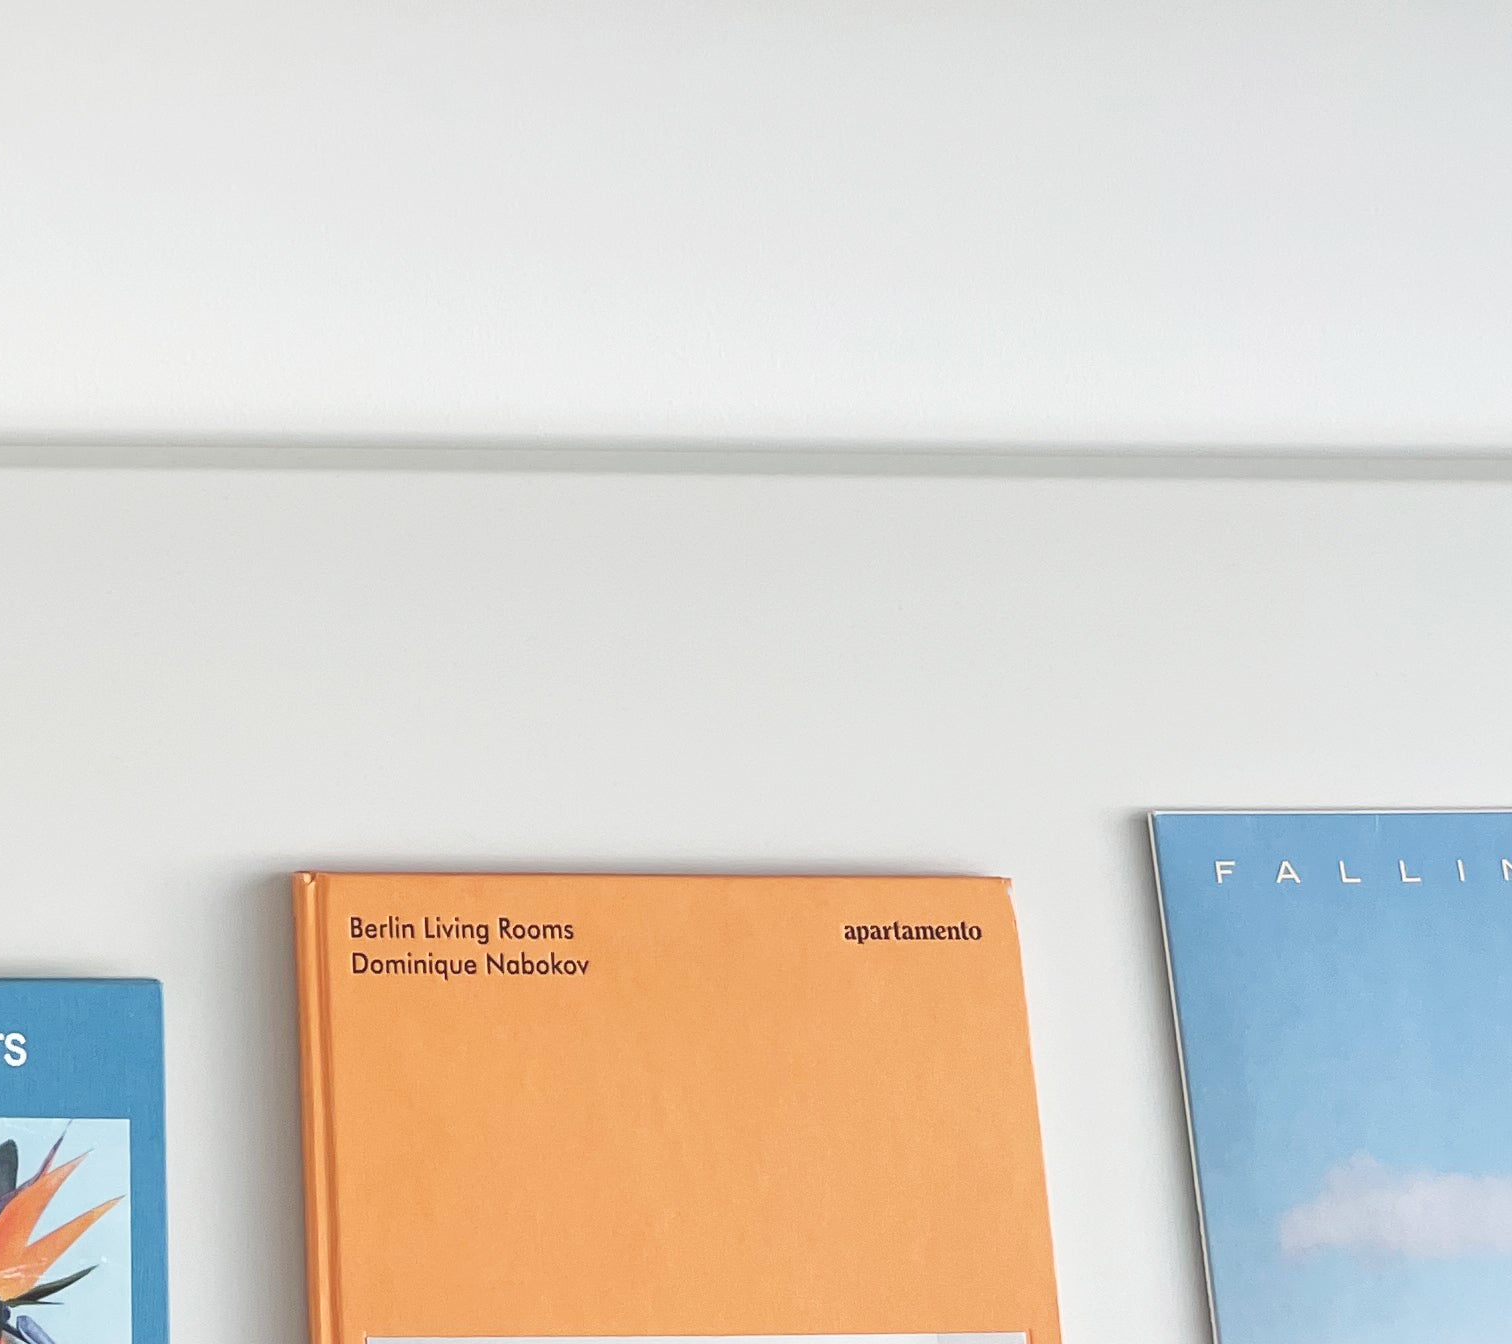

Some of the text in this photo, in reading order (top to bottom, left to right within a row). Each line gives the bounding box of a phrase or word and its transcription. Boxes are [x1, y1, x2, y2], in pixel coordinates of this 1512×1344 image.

[349, 916, 576, 946] Berlin Living Rooms
[843, 920, 983, 945] apartamento
[351, 951, 590, 982] Dominique Nabokov
